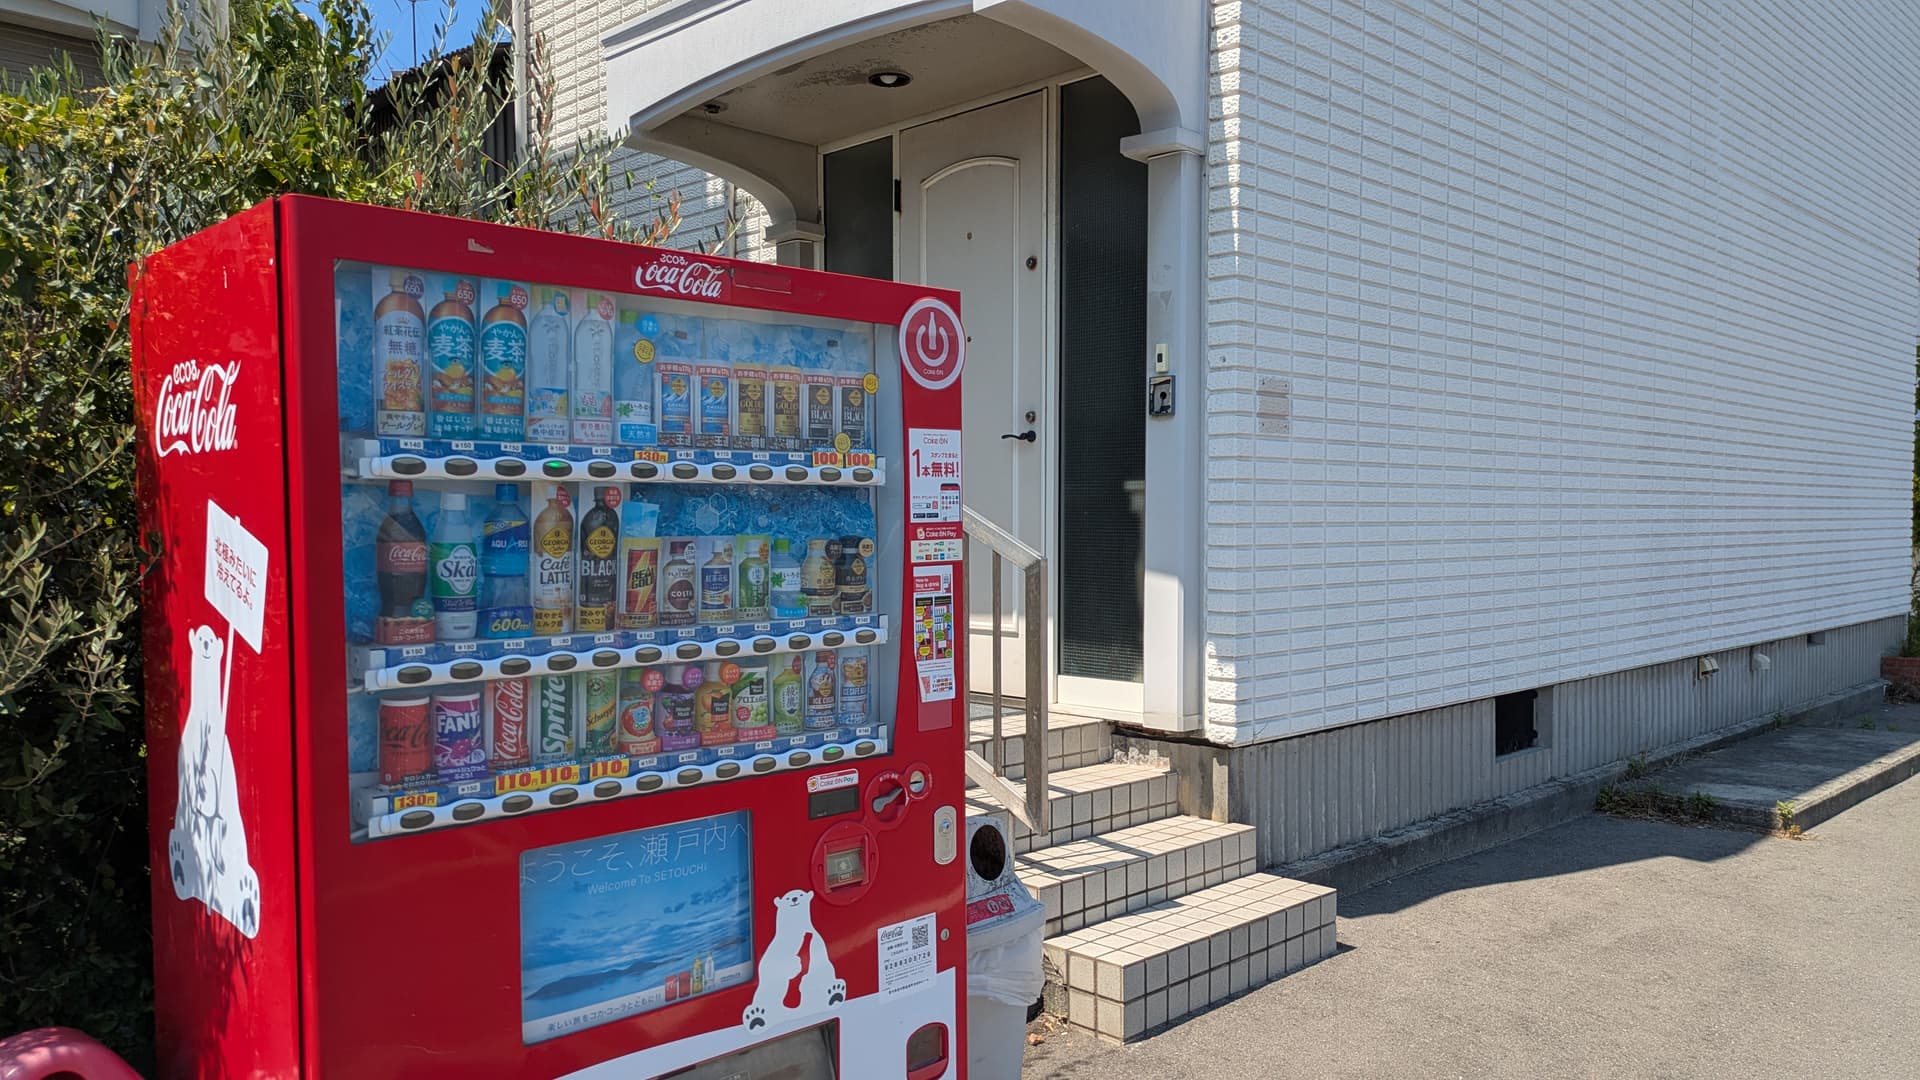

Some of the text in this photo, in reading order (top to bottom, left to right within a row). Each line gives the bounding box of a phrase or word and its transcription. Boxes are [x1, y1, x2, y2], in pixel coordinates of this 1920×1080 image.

[457, 289, 473, 302] 650
[511, 294, 528, 306] 650
[388, 340, 418, 354] 無糖
[430, 335, 474, 360] 麦茶
[483, 340, 526, 363] 麦茶
[155, 360, 241, 457] Coca-Cola
[635, 450, 667, 463] 130円
[947, 530, 957, 538] Pay
[215, 536, 257, 588] 北極みたいに
[540, 556, 571, 572] Café
[581, 559, 617, 577] BLACK
[540, 571, 571, 585] LATTE
[490, 617, 531, 632] 600ml
[494, 679, 524, 760] Coca-Cola
[541, 676, 569, 754] Sprite
[540, 766, 579, 785] 110円
[591, 760, 629, 778] 110円
[497, 772, 539, 791] 110円
[843, 776, 855, 785] Pay
[397, 792, 437, 809] 130円
[520, 822, 749, 886] ようこそ、瀬戸内へ
[587, 862, 708, 896] Welcome To SETOUCHI
